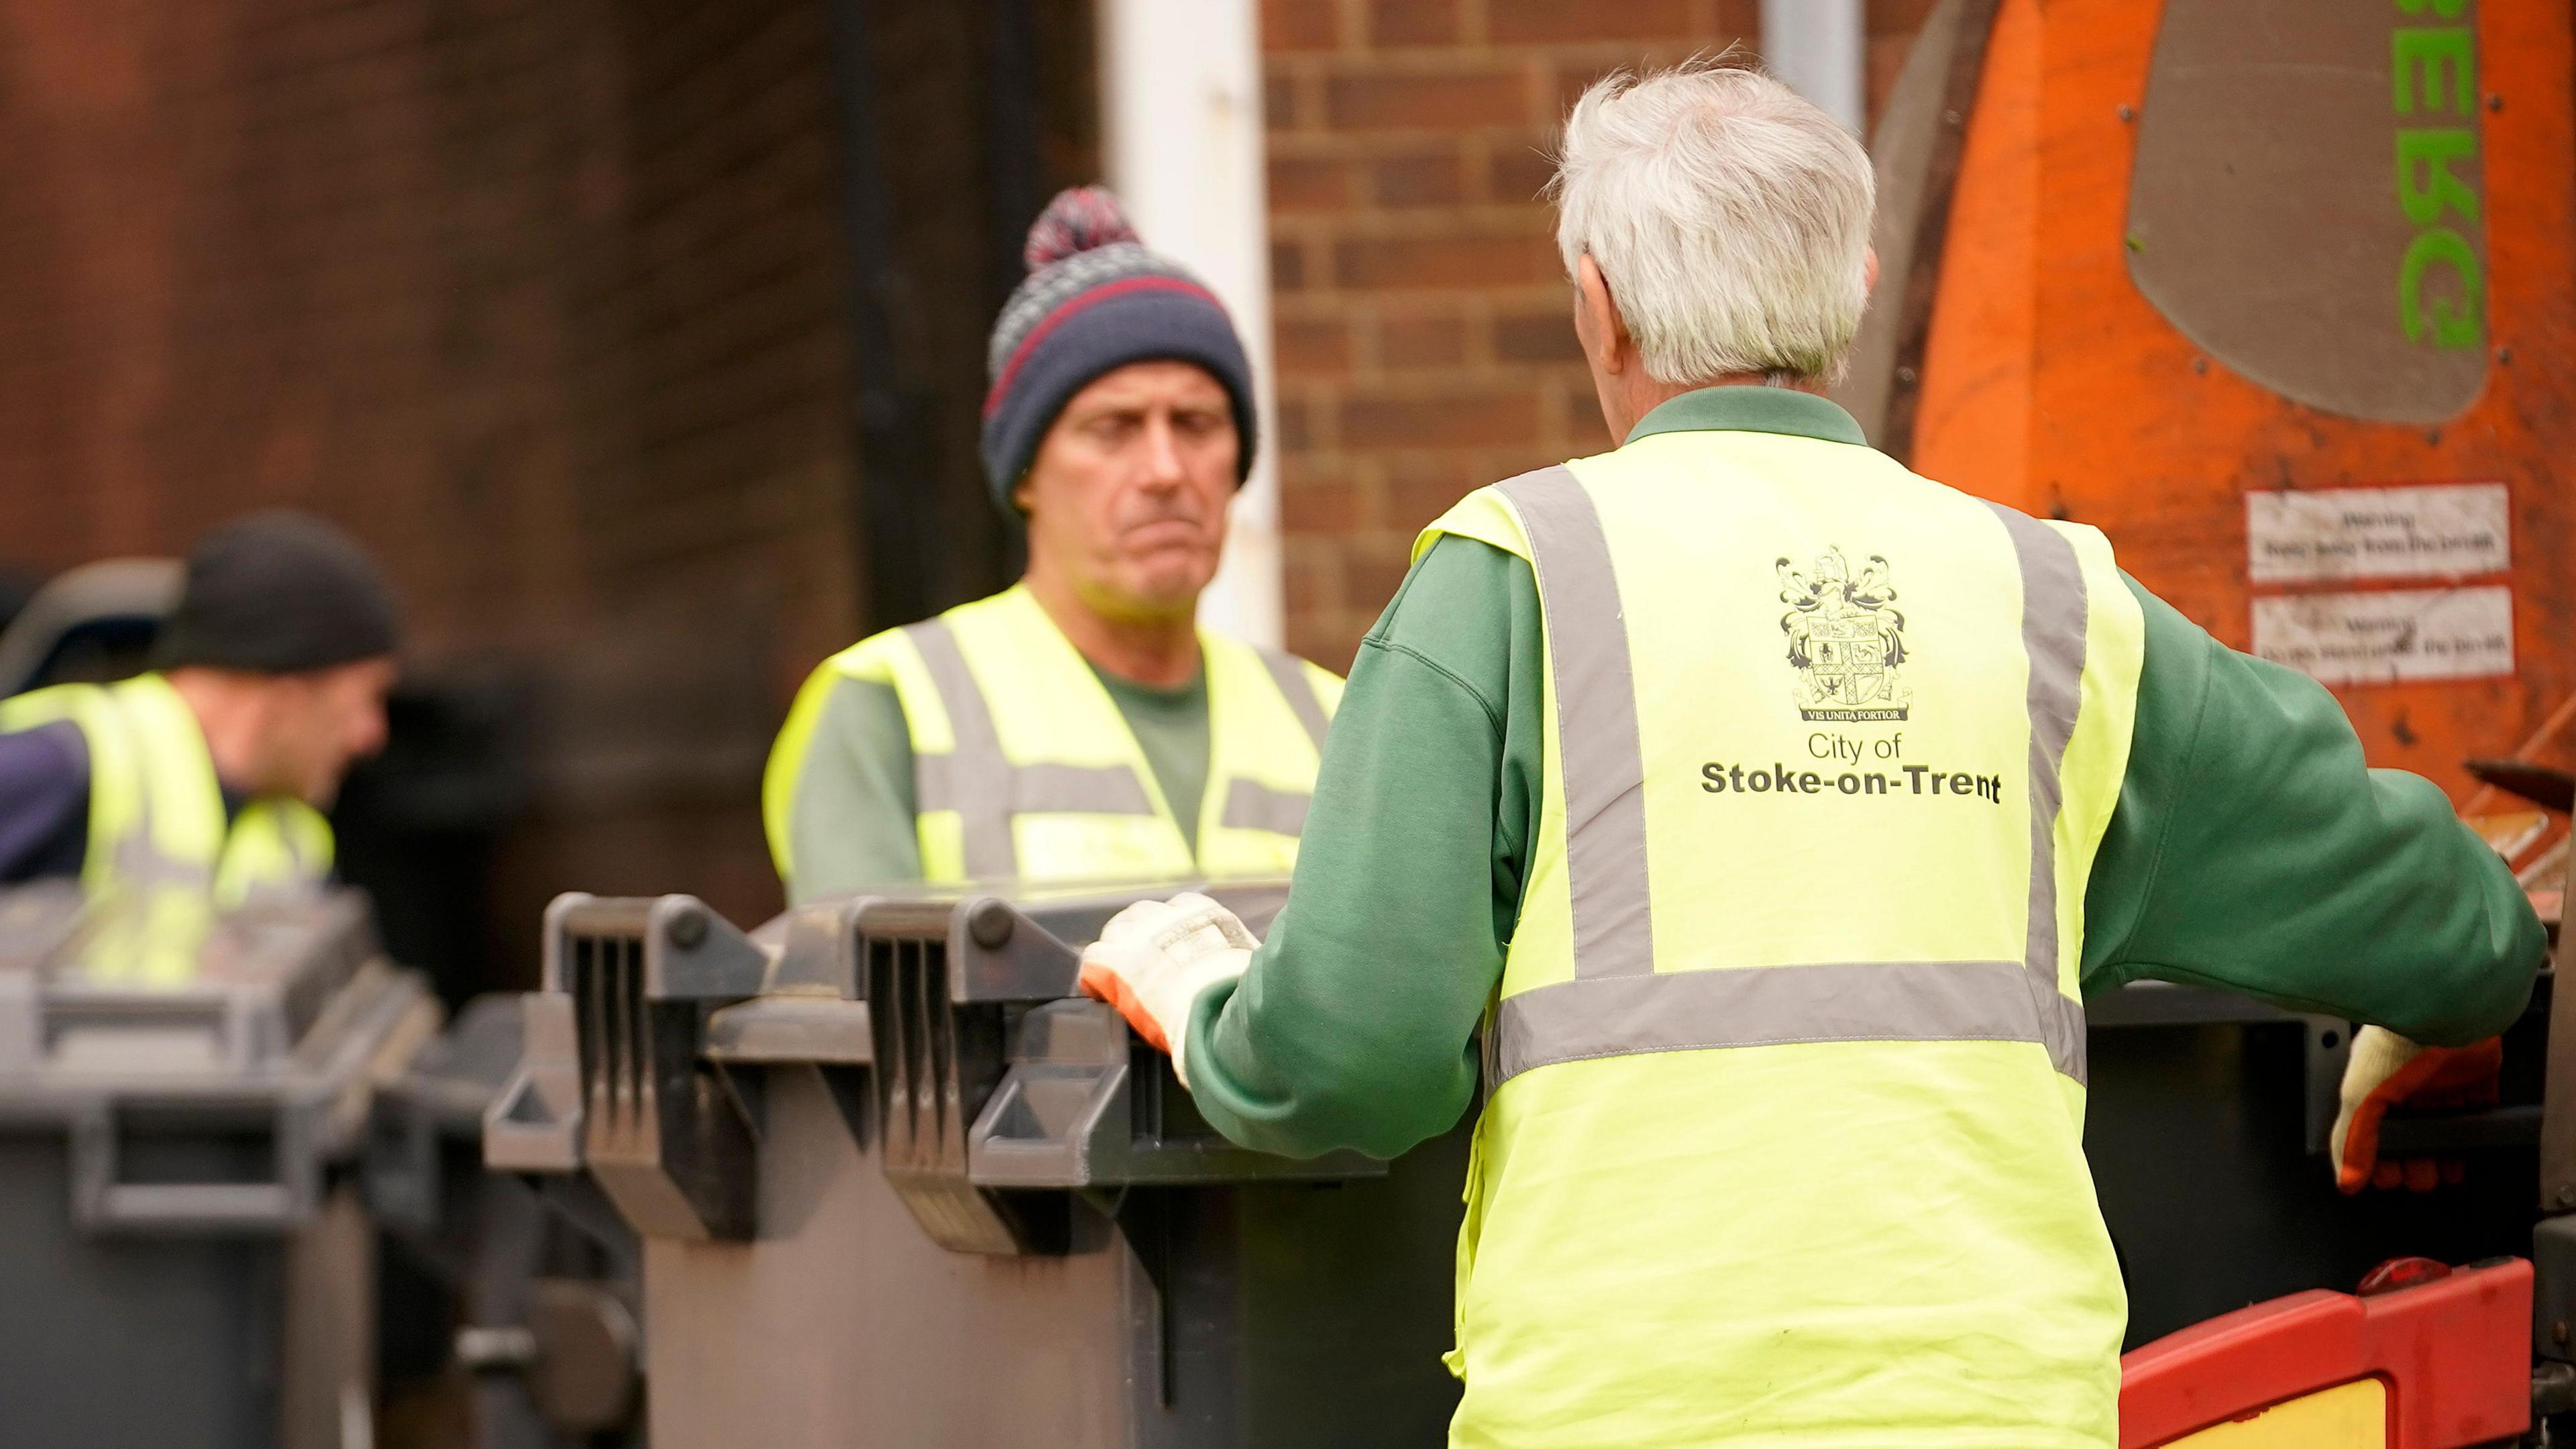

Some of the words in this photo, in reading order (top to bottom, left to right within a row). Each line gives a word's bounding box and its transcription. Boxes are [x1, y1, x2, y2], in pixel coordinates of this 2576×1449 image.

[2392, 0, 2483, 351] ERG
[1807, 710, 1825, 720] VIS
[1825, 710, 1857, 720] UNITA
[1858, 710, 1900, 720] FORTIOR
[1808, 733, 1864, 765] City
[1874, 732, 1902, 759] of
[1701, 761, 2002, 804] Stoke-on-Trent
